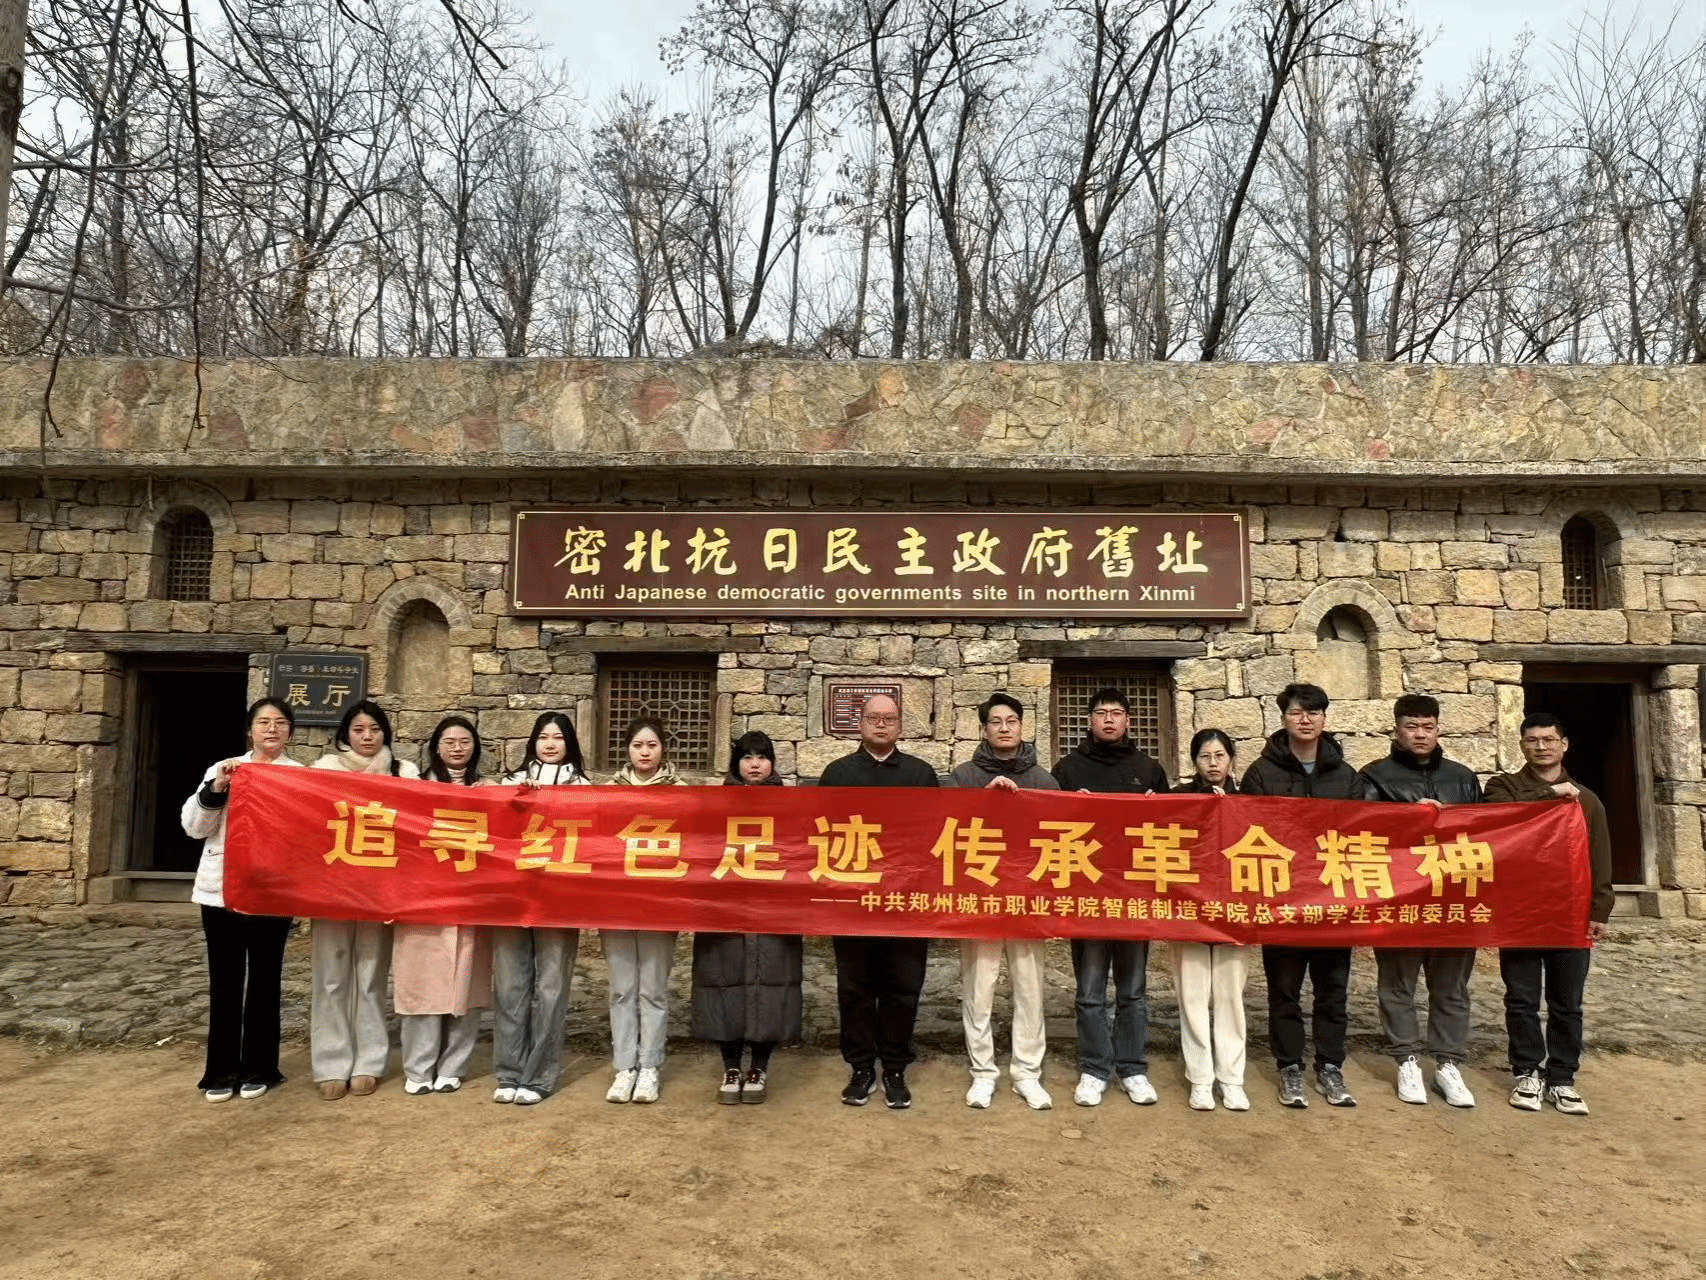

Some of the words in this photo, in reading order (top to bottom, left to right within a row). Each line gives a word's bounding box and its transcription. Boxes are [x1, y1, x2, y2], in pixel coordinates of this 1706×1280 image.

[553, 526, 1209, 578] 密北抗日民主政府舊址
[565, 584, 605, 600] Anti
[615, 584, 707, 602] Japanese
[717, 584, 825, 600] democratic
[835, 584, 962, 603] governments
[972, 585, 1008, 601] site
[1018, 585, 1035, 601] in
[1046, 585, 1129, 601] northern
[1139, 585, 1196, 601] Xinmi
[284, 683, 351, 707] 展厅
[323, 800, 884, 885] 追寻红色足迹
[930, 817, 1495, 898] 传承革命精神
